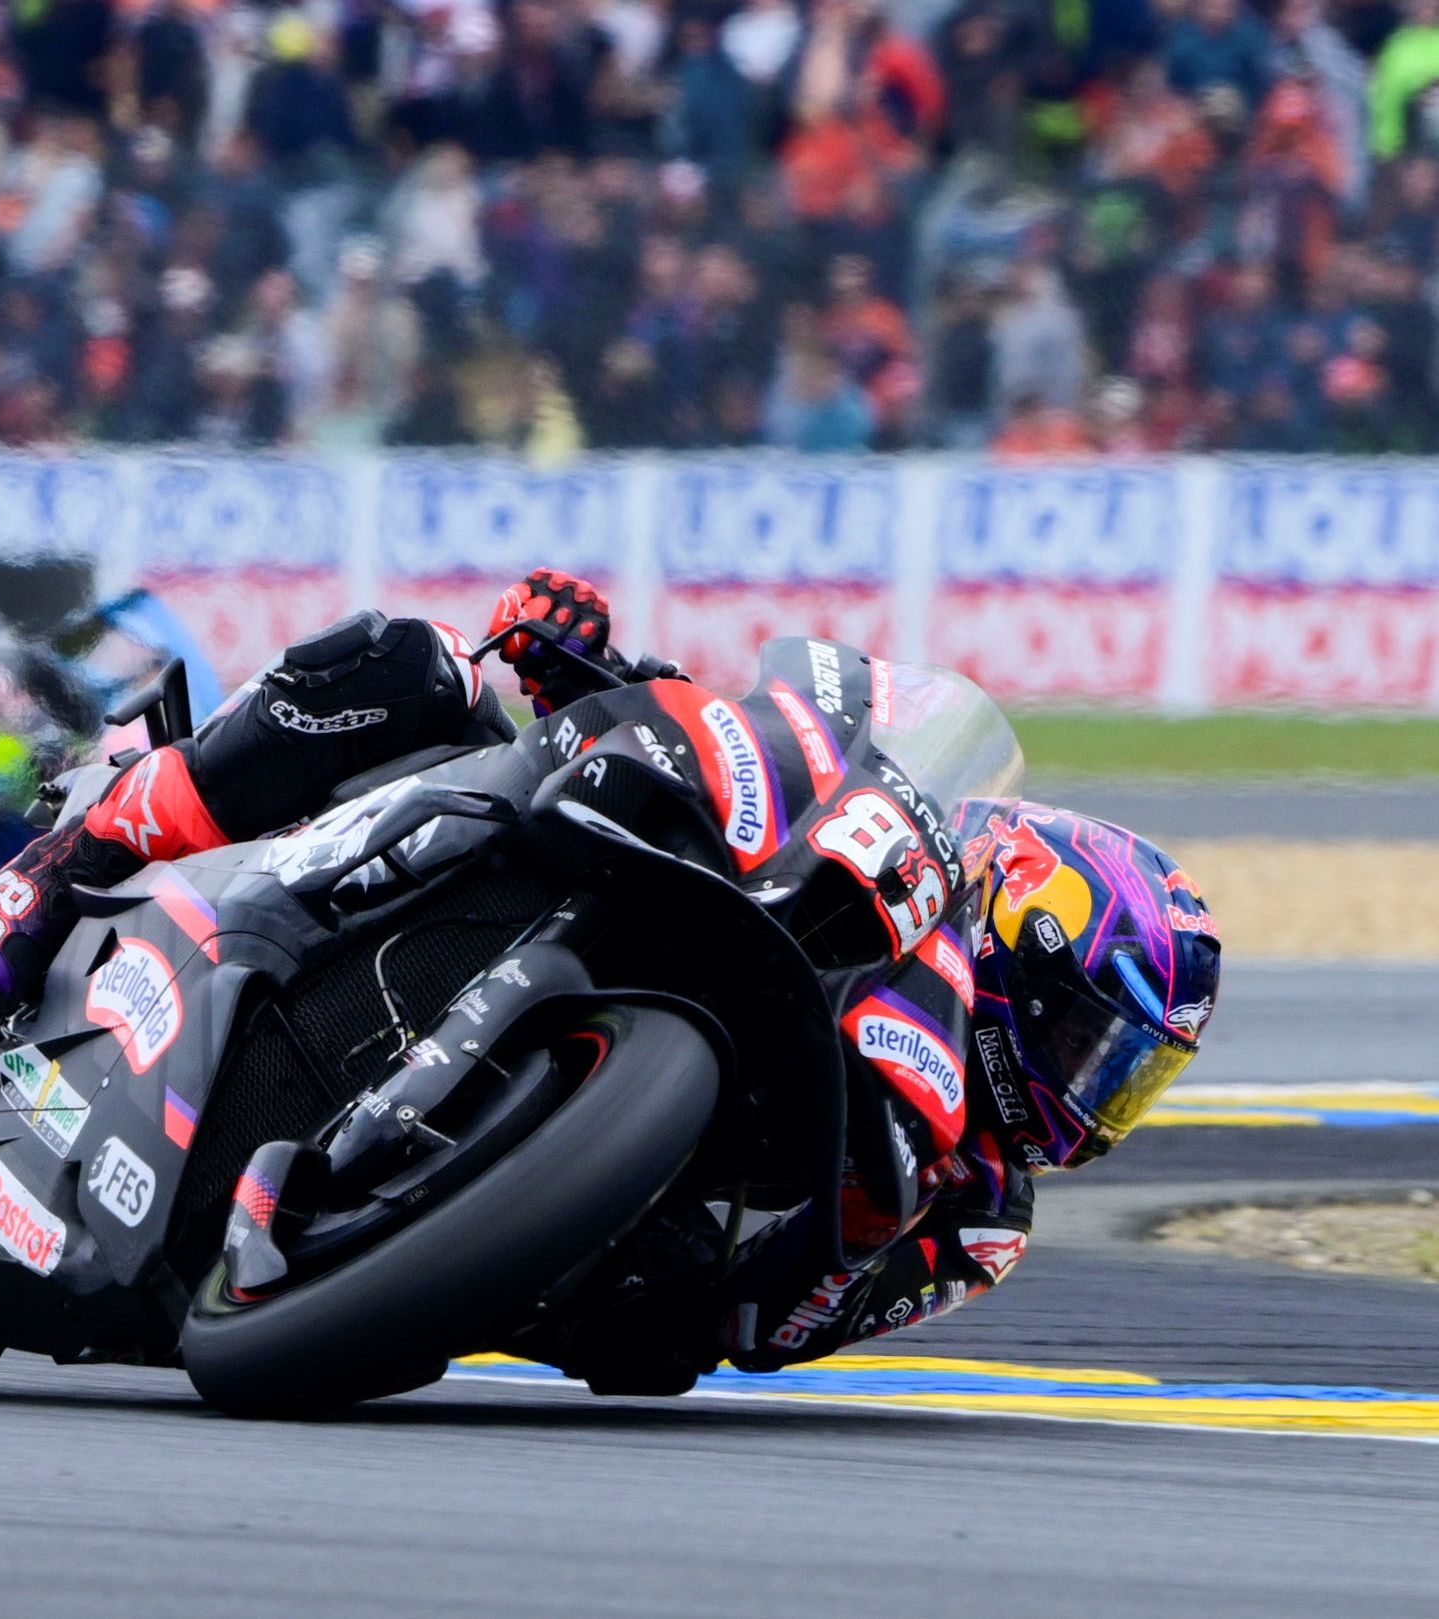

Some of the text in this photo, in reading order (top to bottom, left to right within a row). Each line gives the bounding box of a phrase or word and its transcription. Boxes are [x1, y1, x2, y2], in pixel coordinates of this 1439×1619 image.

[270, 699, 388, 734] alpinestars
[710, 706, 763, 843] sterilgarda
[880, 766, 960, 891] TARGA
[810, 789, 947, 958] 89
[1039, 920, 1061, 947] 100%
[96, 955, 173, 1050] sterilgarda
[865, 1022, 960, 1103] sterilgarda
[105, 1157, 150, 1216] FES
